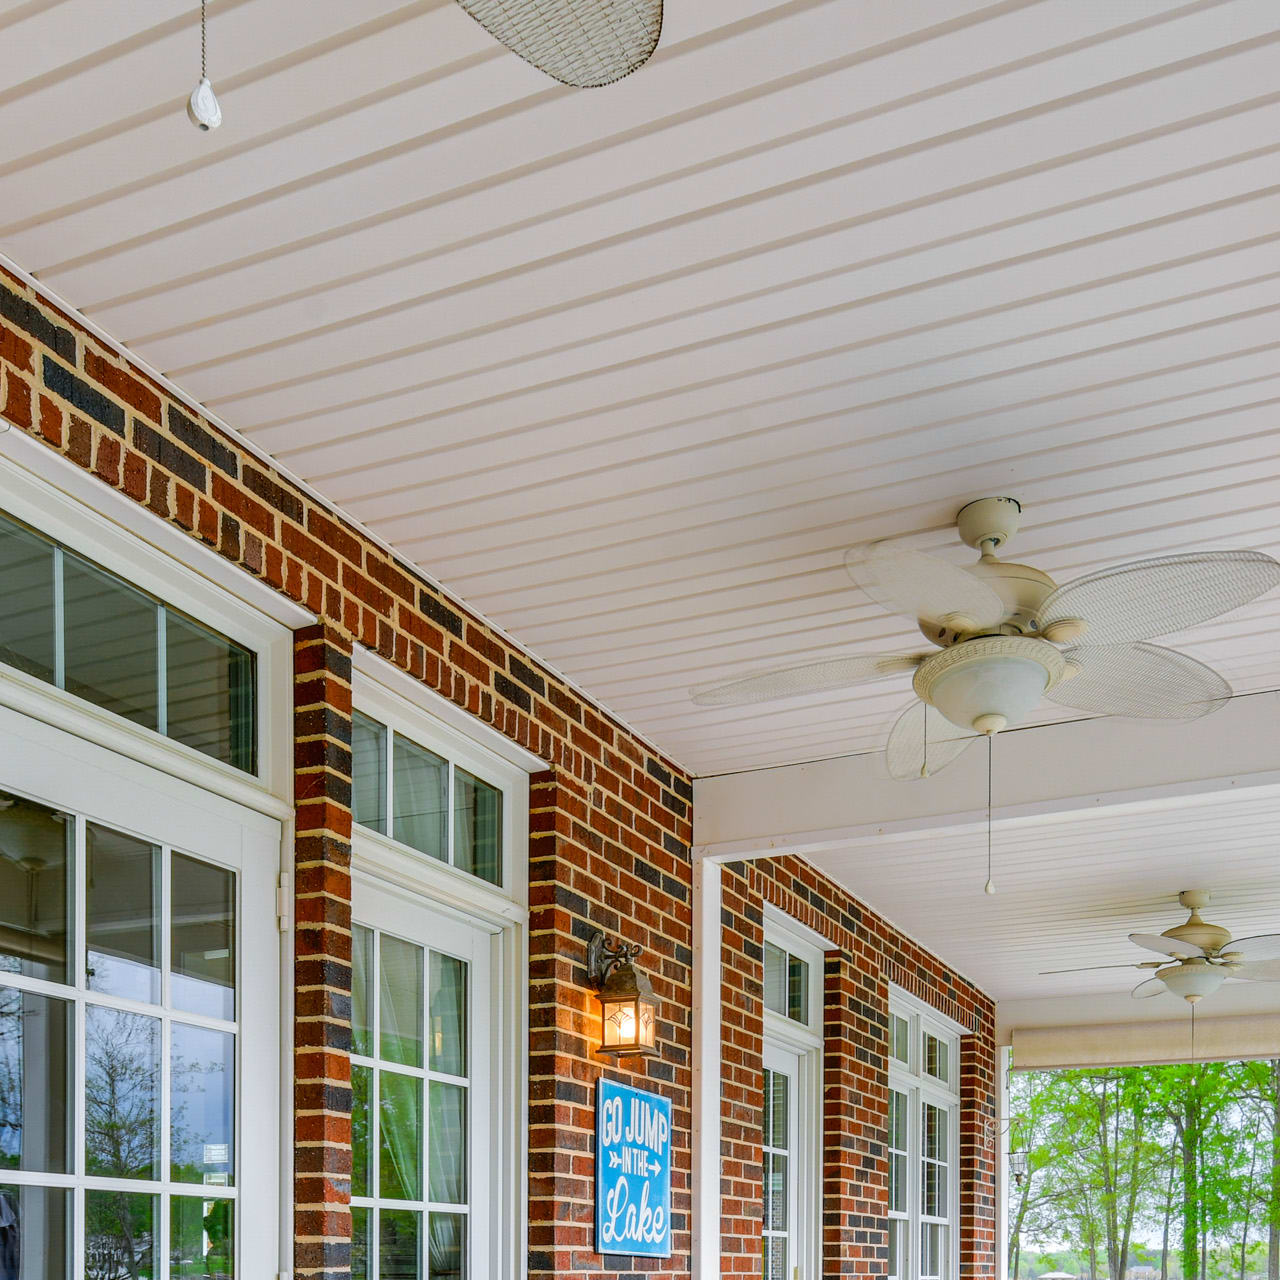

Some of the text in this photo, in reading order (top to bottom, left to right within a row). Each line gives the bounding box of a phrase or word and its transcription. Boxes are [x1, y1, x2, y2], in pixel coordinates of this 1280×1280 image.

[602, 1096, 667, 1156] GO JUMP
[622, 1146, 649, 1177] IN THE
[602, 1175, 667, 1244] Lake
